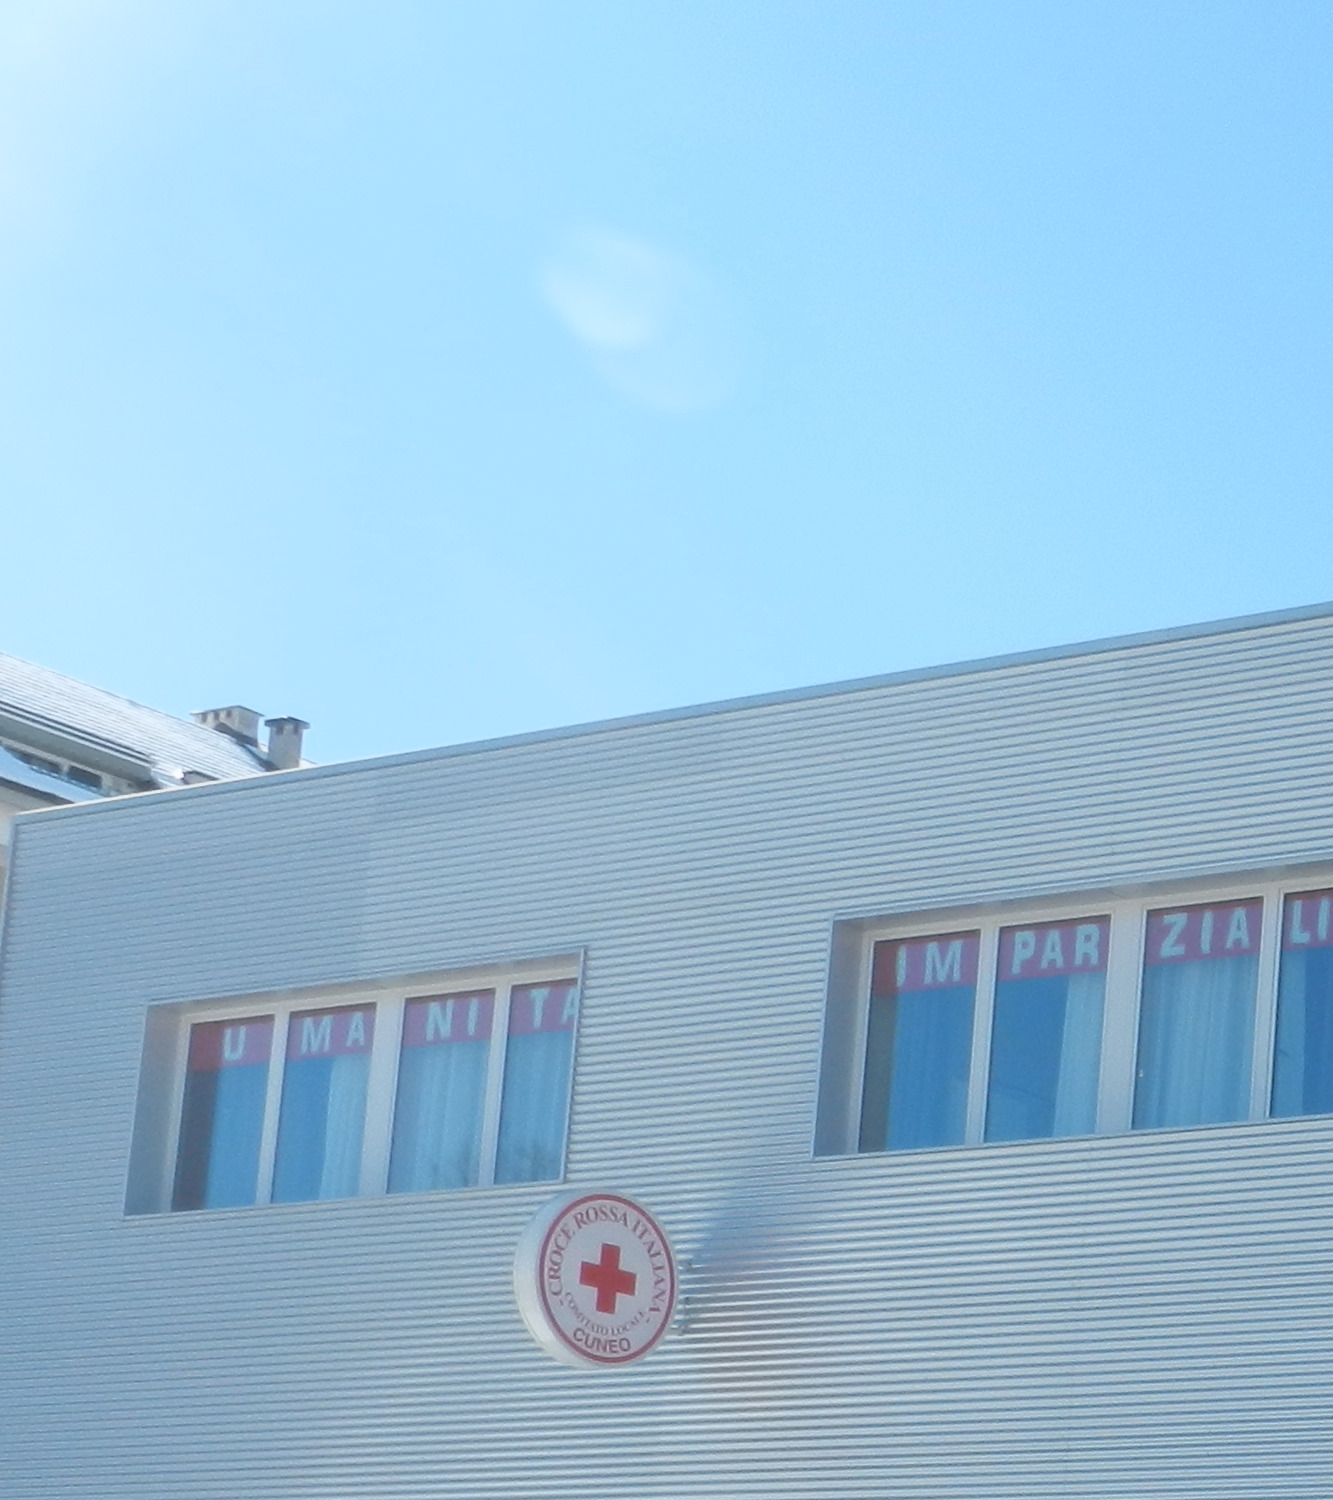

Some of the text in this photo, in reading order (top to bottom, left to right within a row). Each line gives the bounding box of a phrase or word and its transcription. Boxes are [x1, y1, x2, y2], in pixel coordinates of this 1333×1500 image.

[548, 1205, 667, 1313] CROCE ROSSA ITALIANA
[573, 1326, 631, 1353] CUNEO
